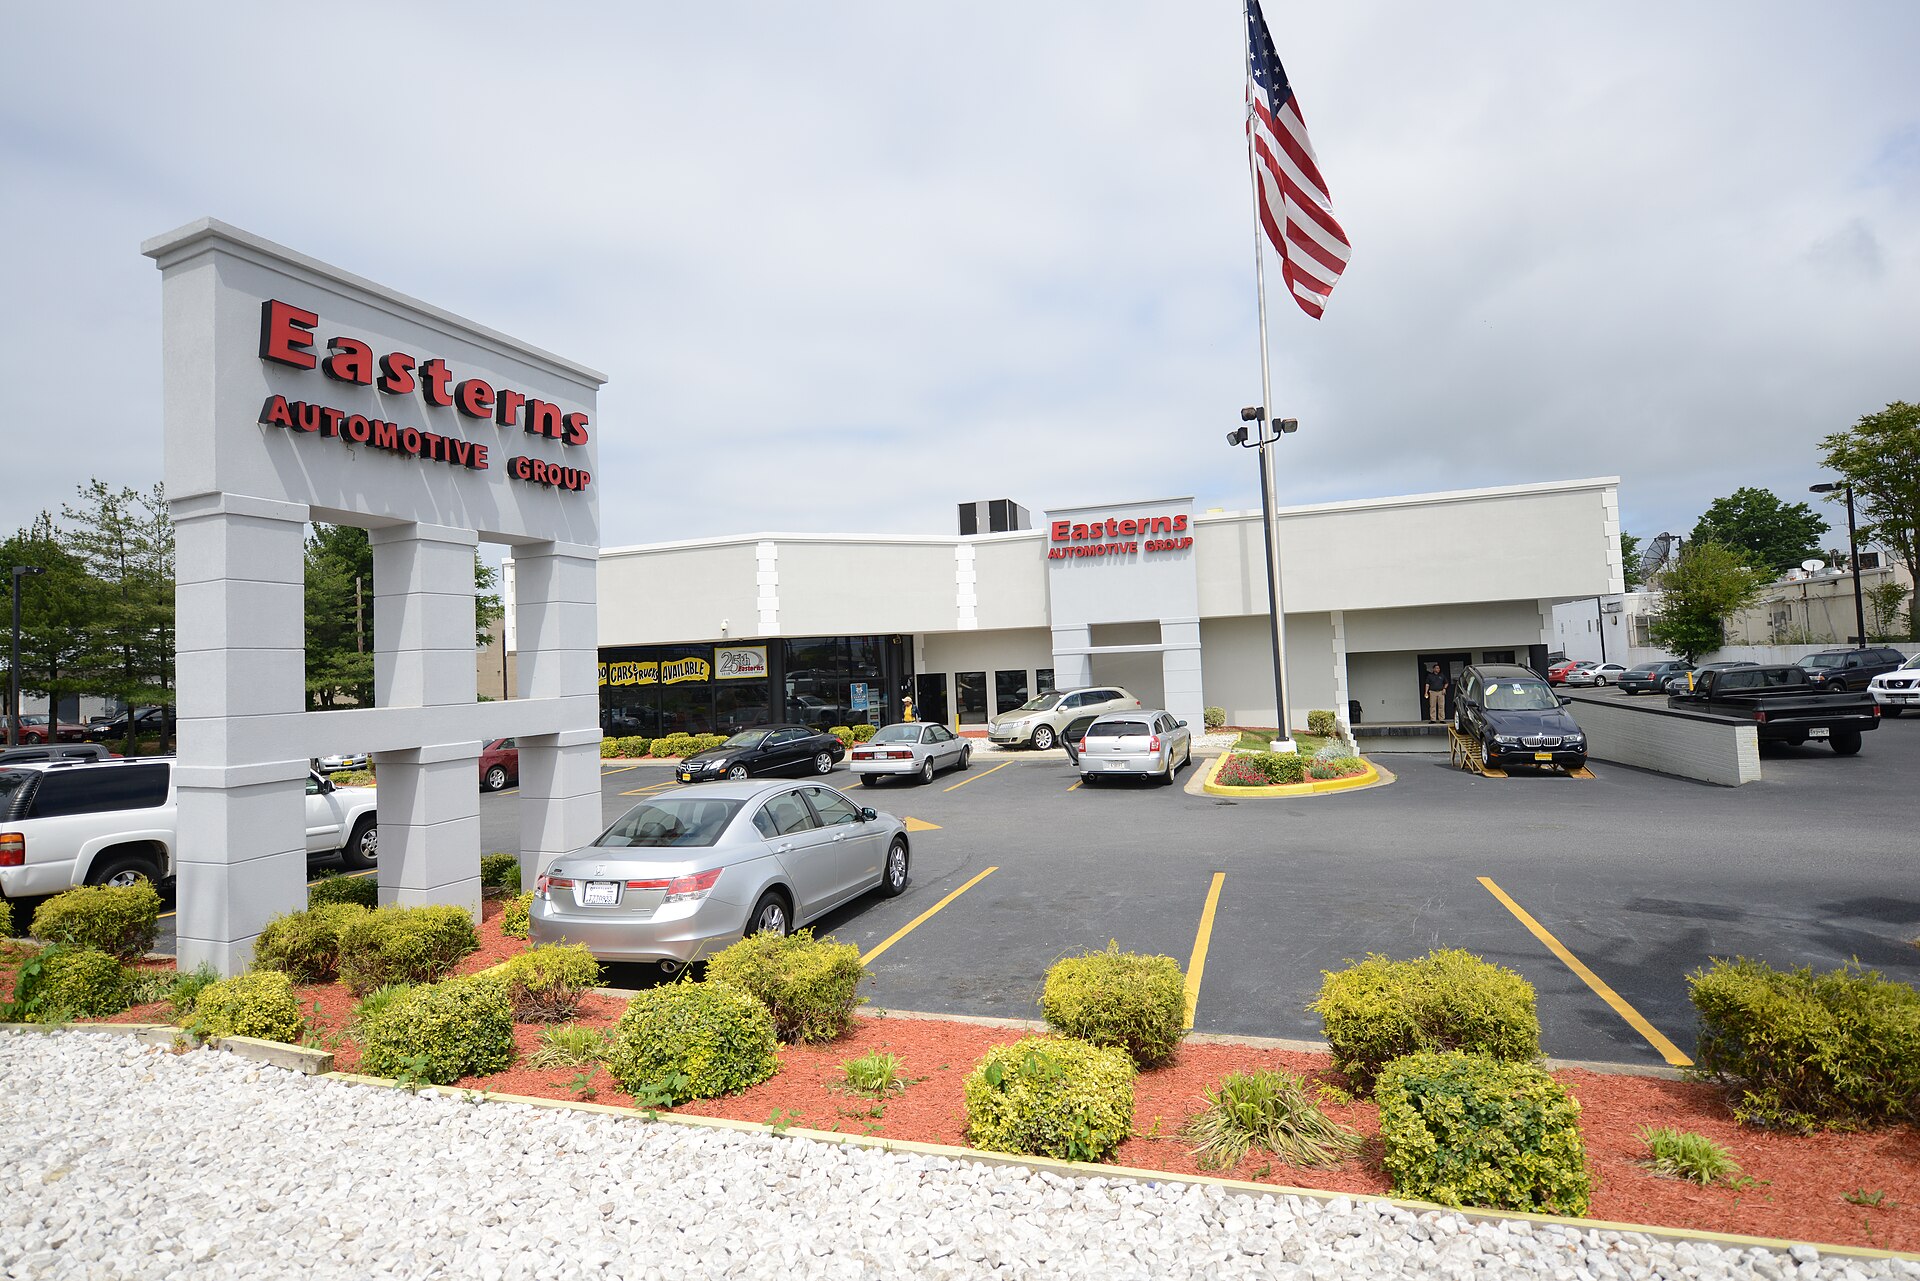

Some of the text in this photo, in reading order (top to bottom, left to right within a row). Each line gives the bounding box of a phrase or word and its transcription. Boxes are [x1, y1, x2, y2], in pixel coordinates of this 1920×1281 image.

[259, 299, 589, 446] Easterns
[258, 394, 591, 492] AUTOMOTIVE GROUP
[1052, 515, 1187, 541] Easterns
[1048, 537, 1193, 559] AUTOMOTIVE GROUP
[610, 665, 632, 683] CARS
[634, 667, 659, 682] TRUCKS
[662, 661, 704, 682] AVAILABLE
